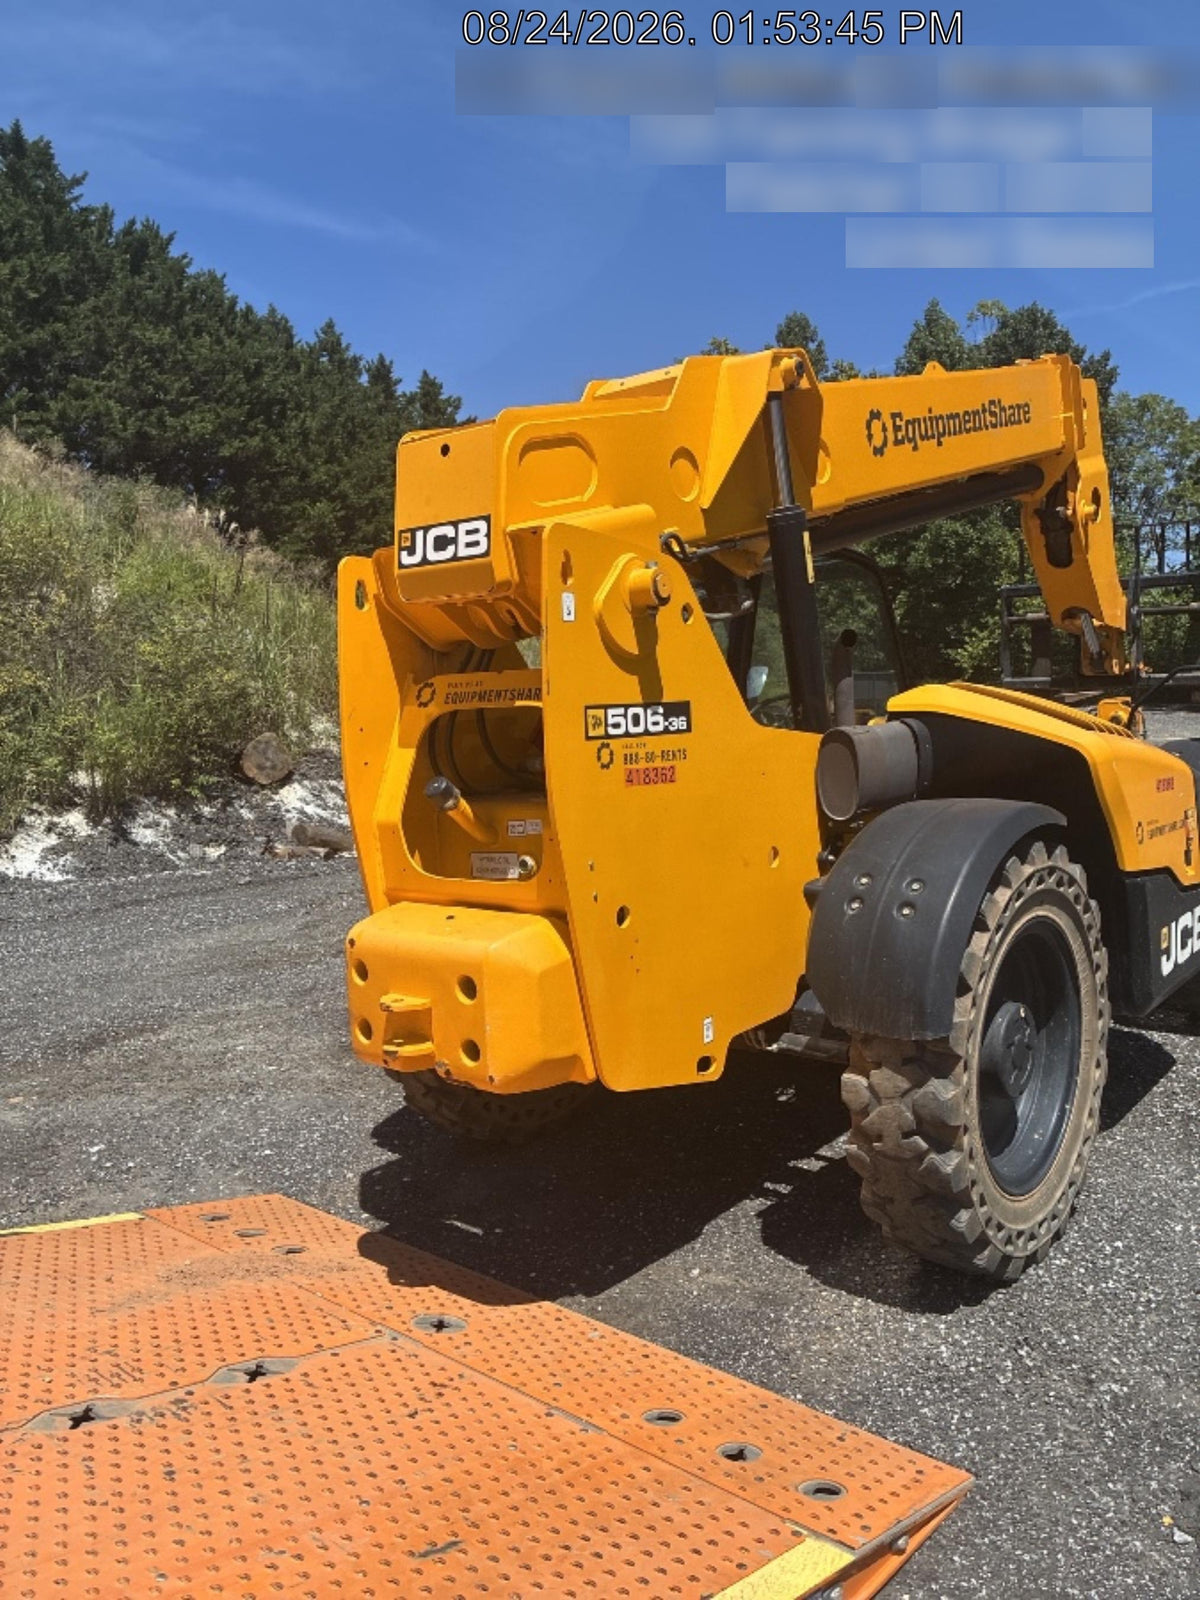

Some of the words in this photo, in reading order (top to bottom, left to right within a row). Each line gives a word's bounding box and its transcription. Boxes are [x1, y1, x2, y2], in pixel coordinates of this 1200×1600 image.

[890, 398, 1031, 452] EquipmentShare
[400, 519, 488, 566] JCB
[606, 705, 687, 735] 506-36
[625, 765, 677, 786] 418362
